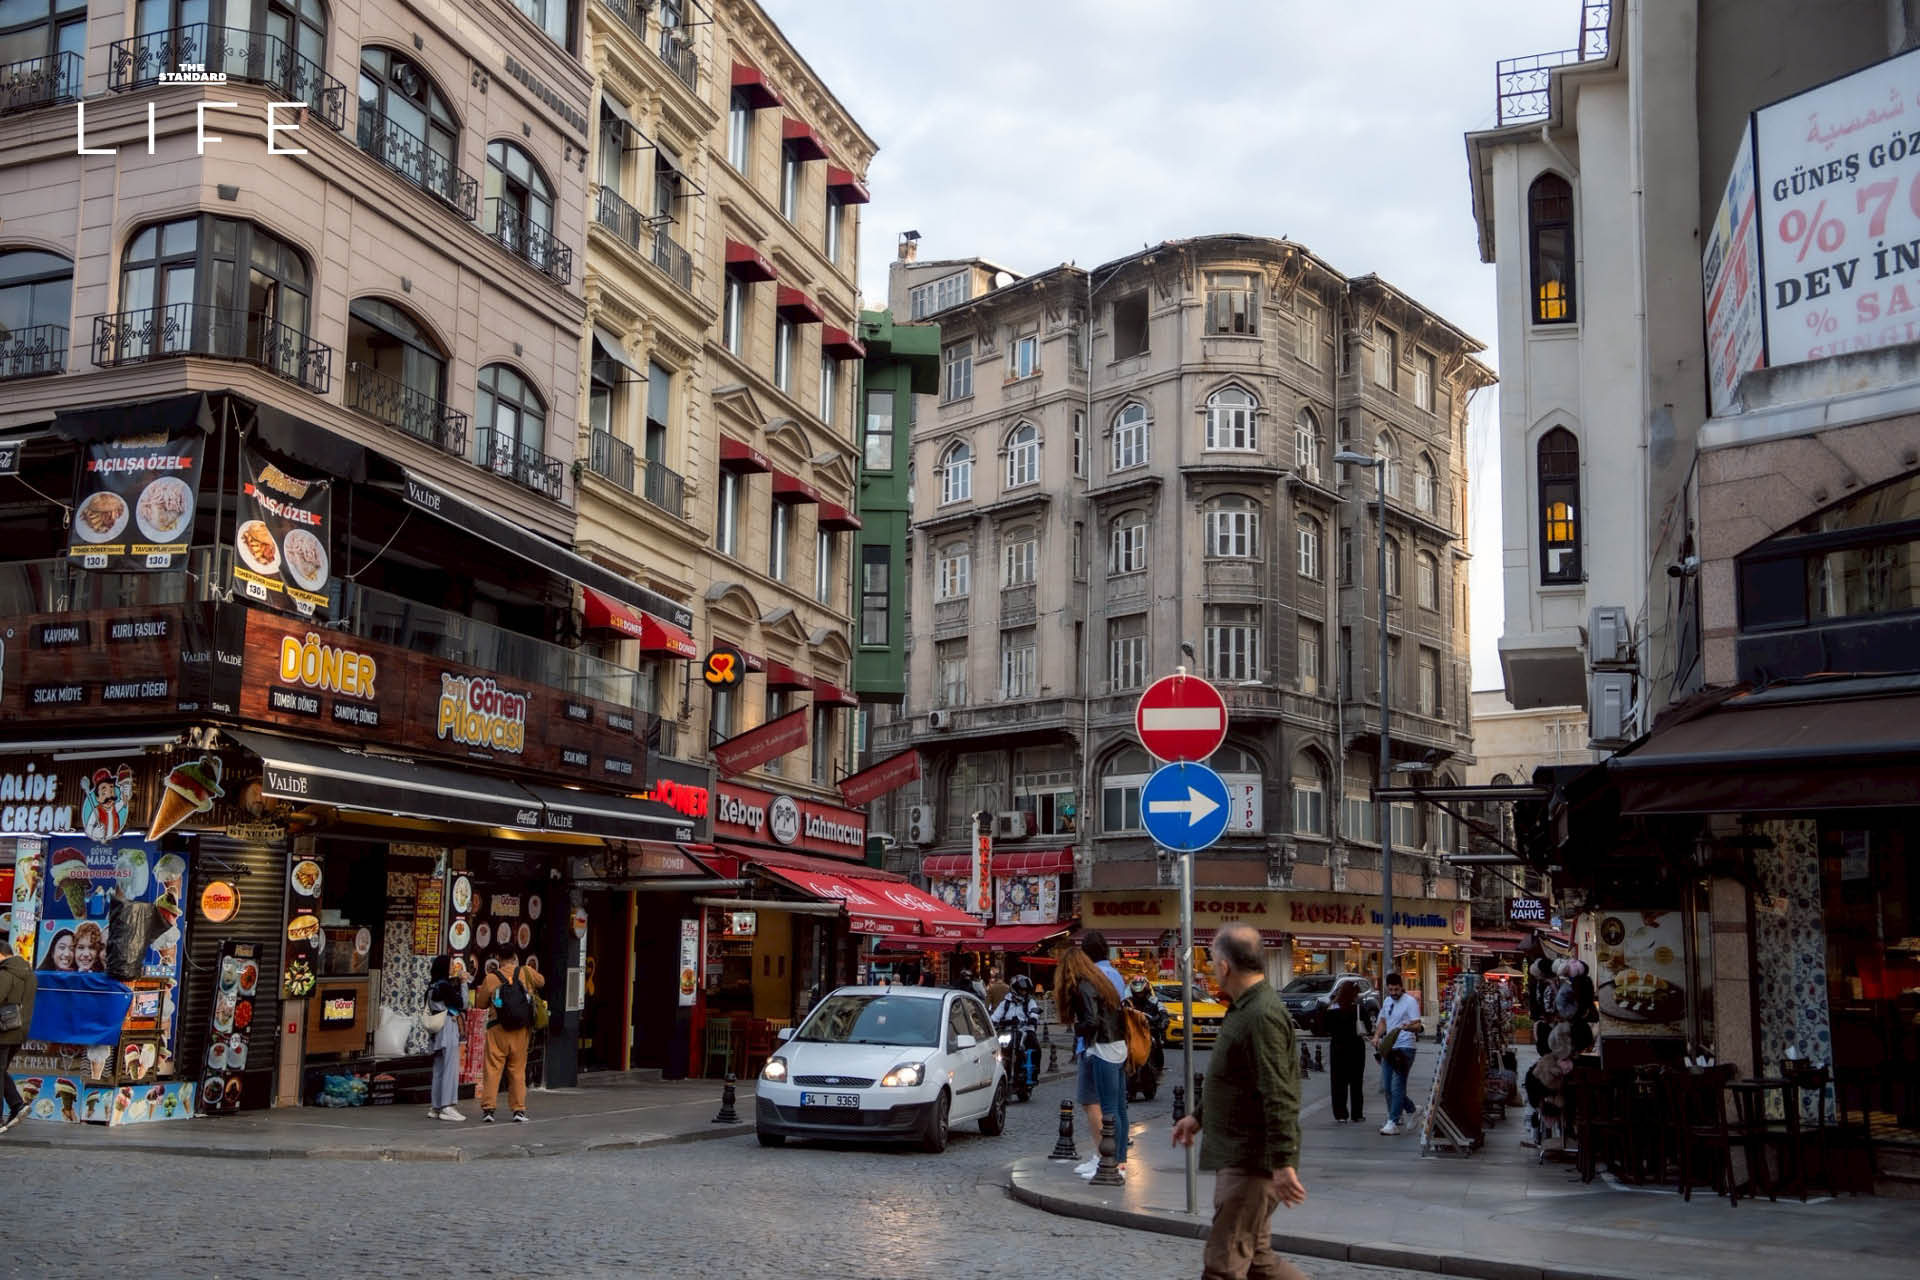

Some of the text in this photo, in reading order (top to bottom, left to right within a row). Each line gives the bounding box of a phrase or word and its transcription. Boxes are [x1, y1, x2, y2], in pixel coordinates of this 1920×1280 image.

[1773, 153, 1860, 202] GÜNEŞ
[1775, 258, 1859, 310] DEV
[1856, 280, 1920, 323] SA
[93, 453, 184, 475] AÇILIŞA ÖZEL
[44, 628, 80, 643] KAVURMA
[112, 621, 167, 639] KURU FASULYE
[280, 631, 377, 700] DÖNER
[34, 686, 82, 703] SICAK MİDYE
[104, 679, 168, 699] ARNAVUT CİĞERİ
[469, 677, 526, 721] Gönen
[273, 692, 318, 713] TOMBİK DÖNER
[359, 709, 379, 725] DÖNER
[0, 762, 58, 801] ALİDE
[1, 805, 73, 833] CREAM
[719, 794, 765, 832] Kebap
[805, 812, 864, 846] Lahmacun
[1092, 901, 1161, 917] KOSKA
[1194, 901, 1267, 914] KOSKA
[1290, 901, 1366, 926] KOSKA
[1512, 898, 1542, 909] KÖZDE
[1510, 909, 1545, 920] KAHVE
[806, 1095, 816, 1105] 34
[823, 1095, 830, 1105] T
